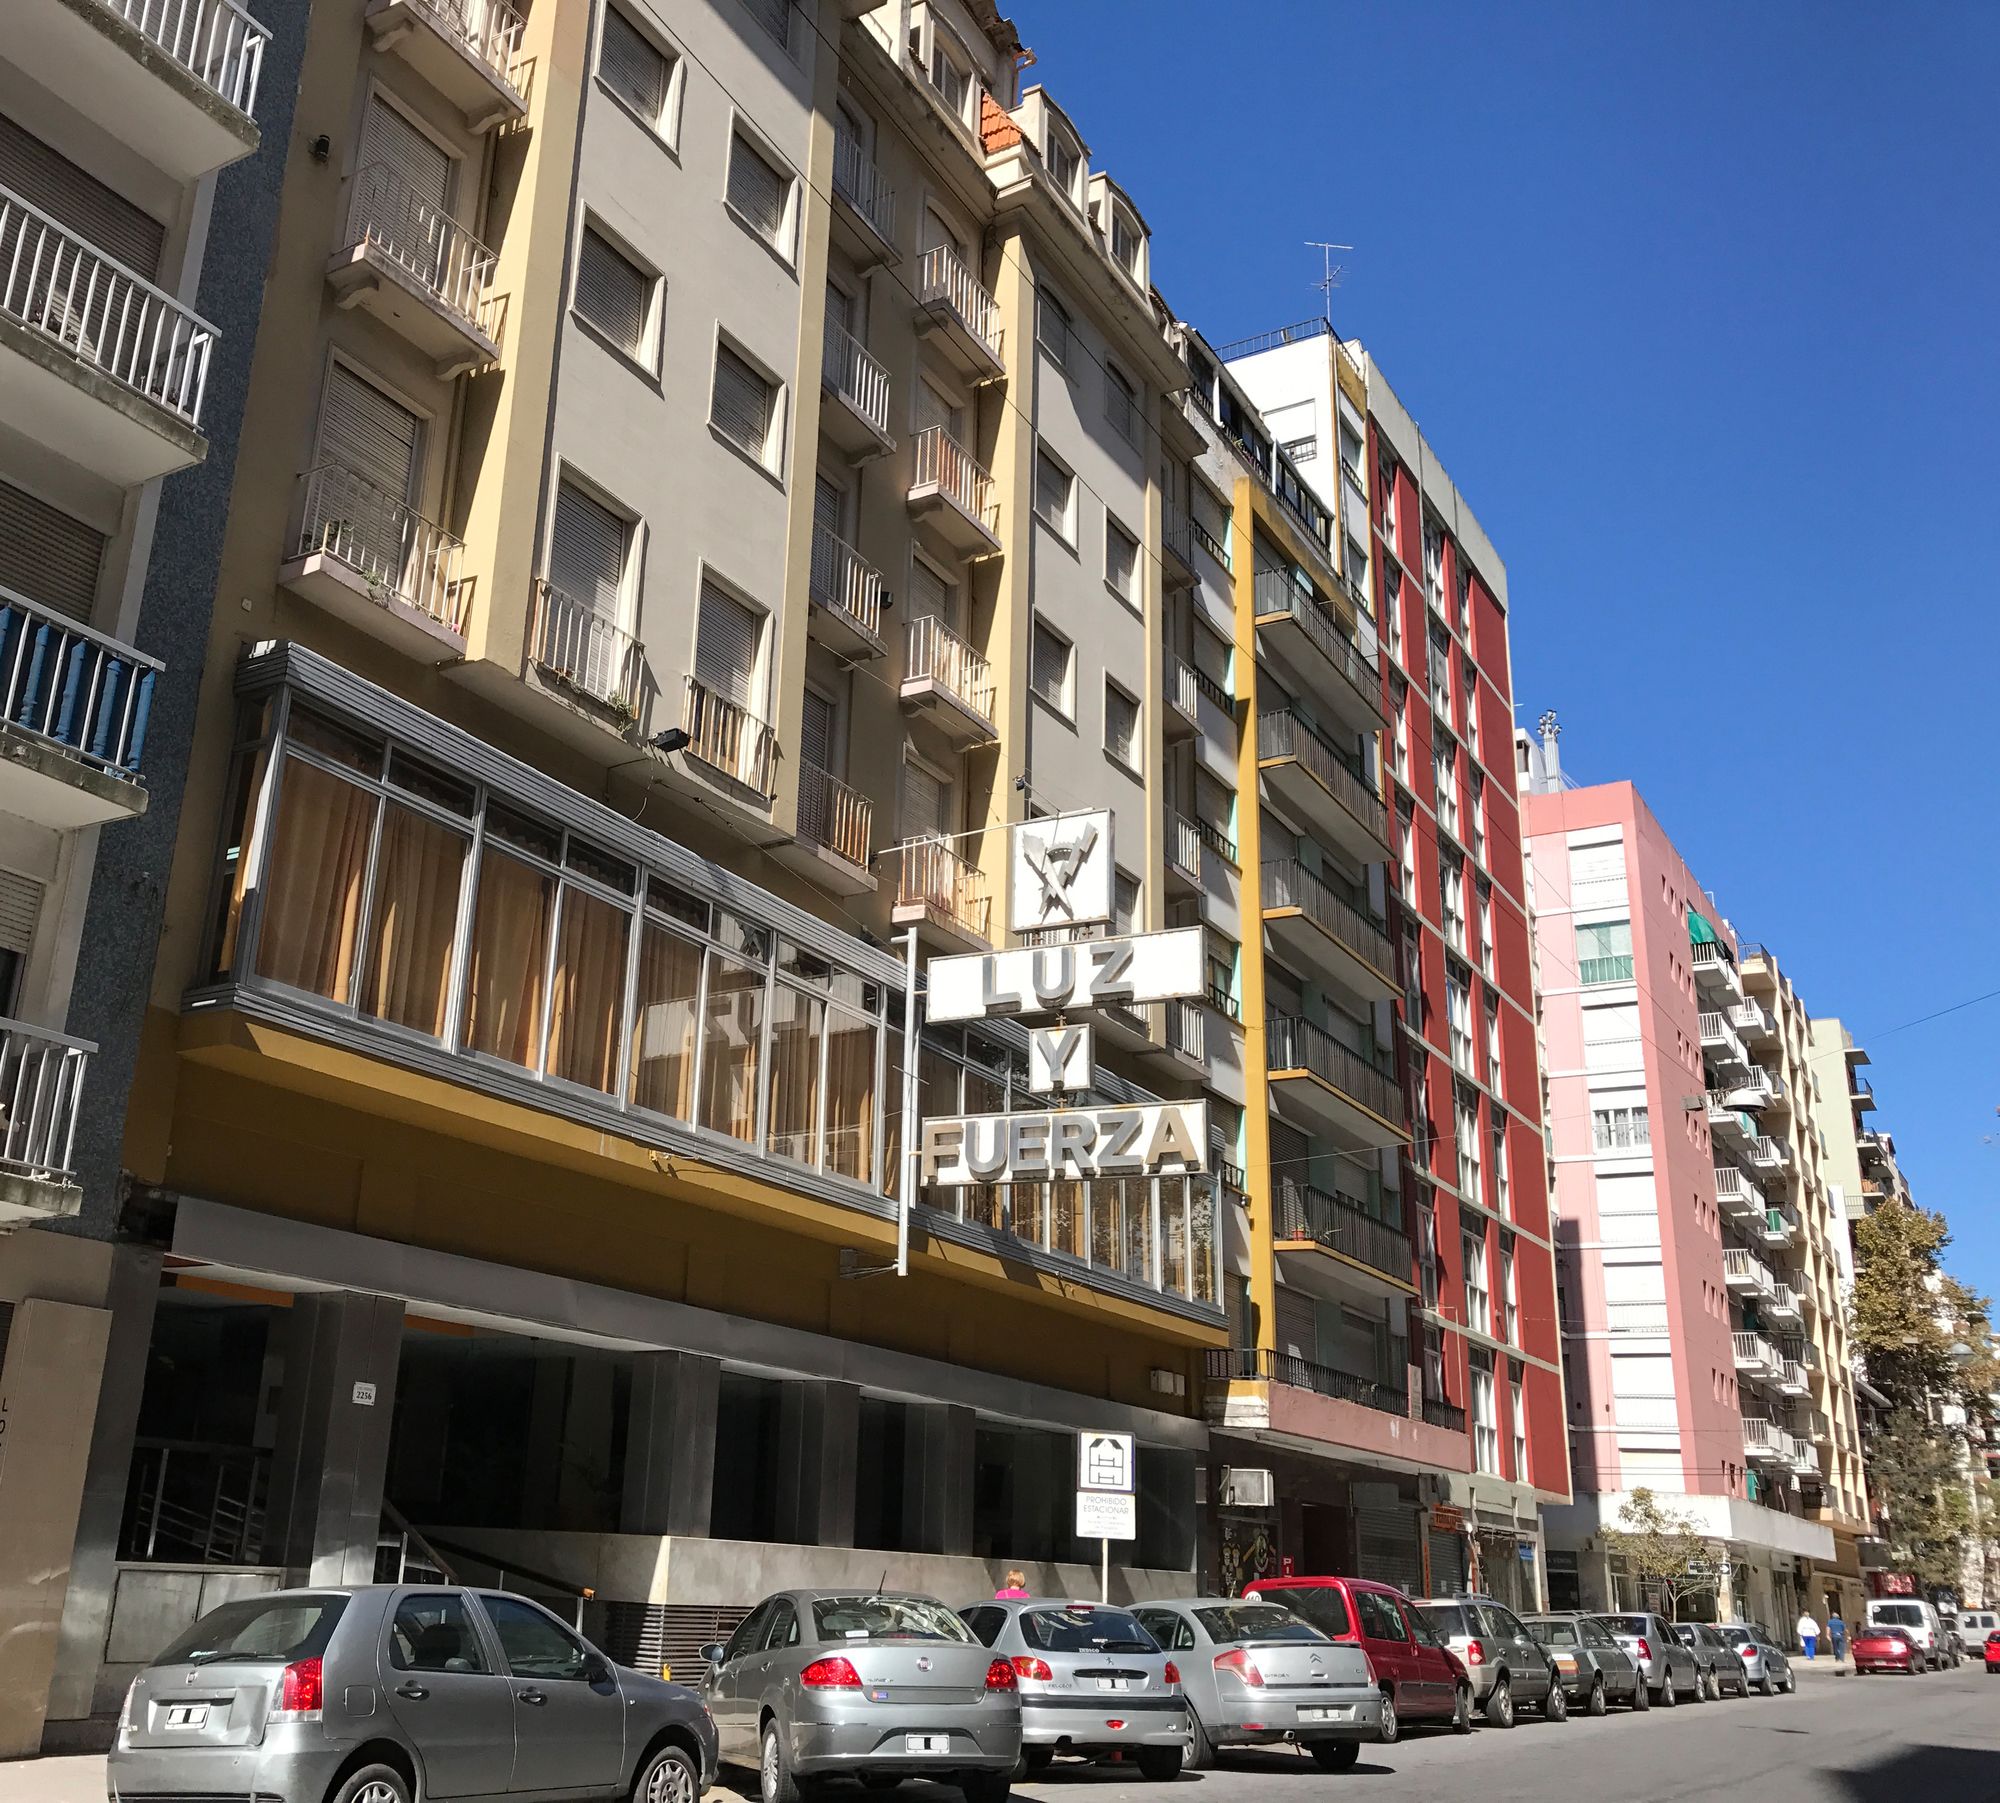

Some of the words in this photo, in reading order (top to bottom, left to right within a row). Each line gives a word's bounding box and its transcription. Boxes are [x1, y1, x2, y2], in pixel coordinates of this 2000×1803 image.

[982, 940, 1134, 1008] LUZ
[1036, 1028, 1080, 1084] Y
[922, 1107, 1200, 1178] FUERZA
[356, 1391, 372, 1400] 2256
[1083, 1505, 1129, 1515] ESTACIONAR
[1086, 1495, 1127, 1505] PROHIBIDO
[1283, 1557, 1292, 1578] PI
